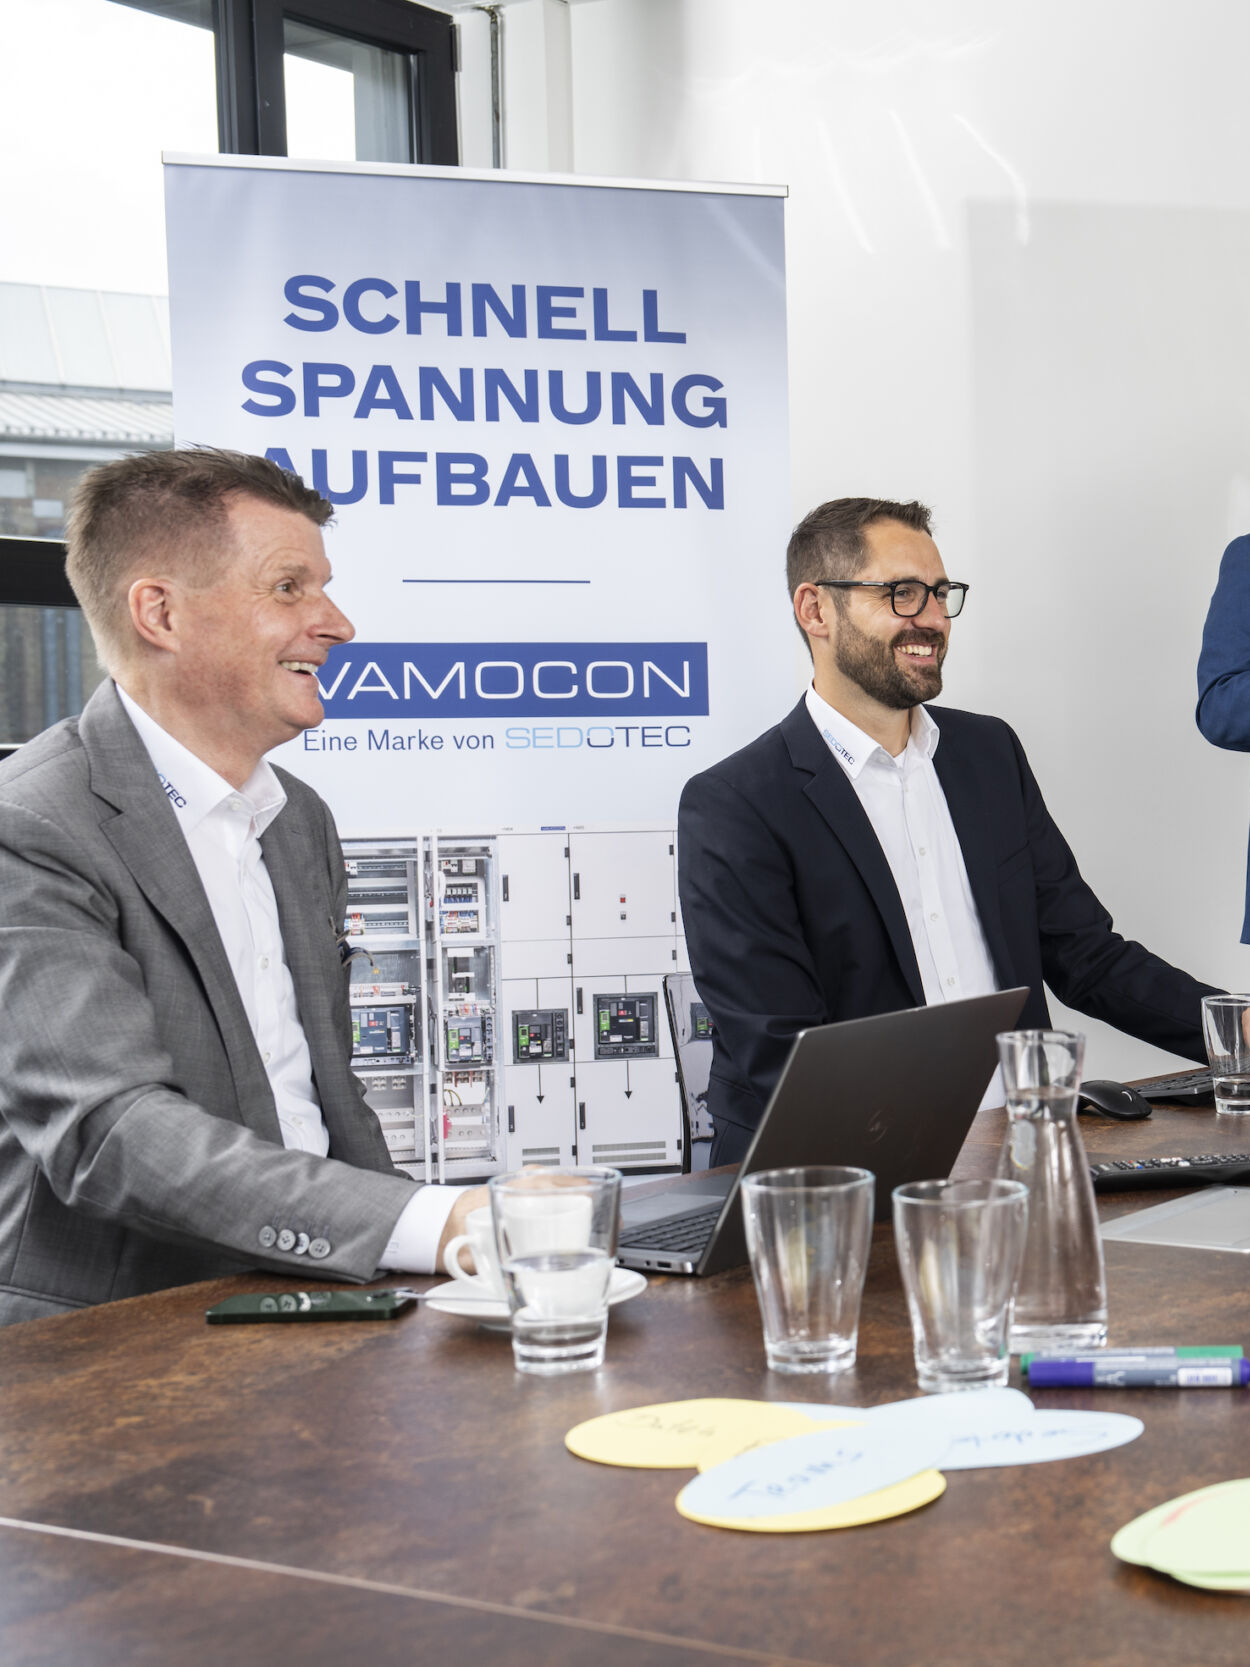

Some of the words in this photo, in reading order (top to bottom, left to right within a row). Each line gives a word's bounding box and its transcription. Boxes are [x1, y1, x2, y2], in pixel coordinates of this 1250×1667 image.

[282, 274, 688, 344] SCHNELL
[240, 359, 728, 429] SPANNUNG
[317, 660, 691, 701] VAMOCON
[303, 727, 359, 751] Eine
[367, 727, 444, 751] Marke
[452, 732, 495, 750] von
[504, 724, 692, 750] SEDOTEC
[823, 729, 855, 765] SEDOTEC
